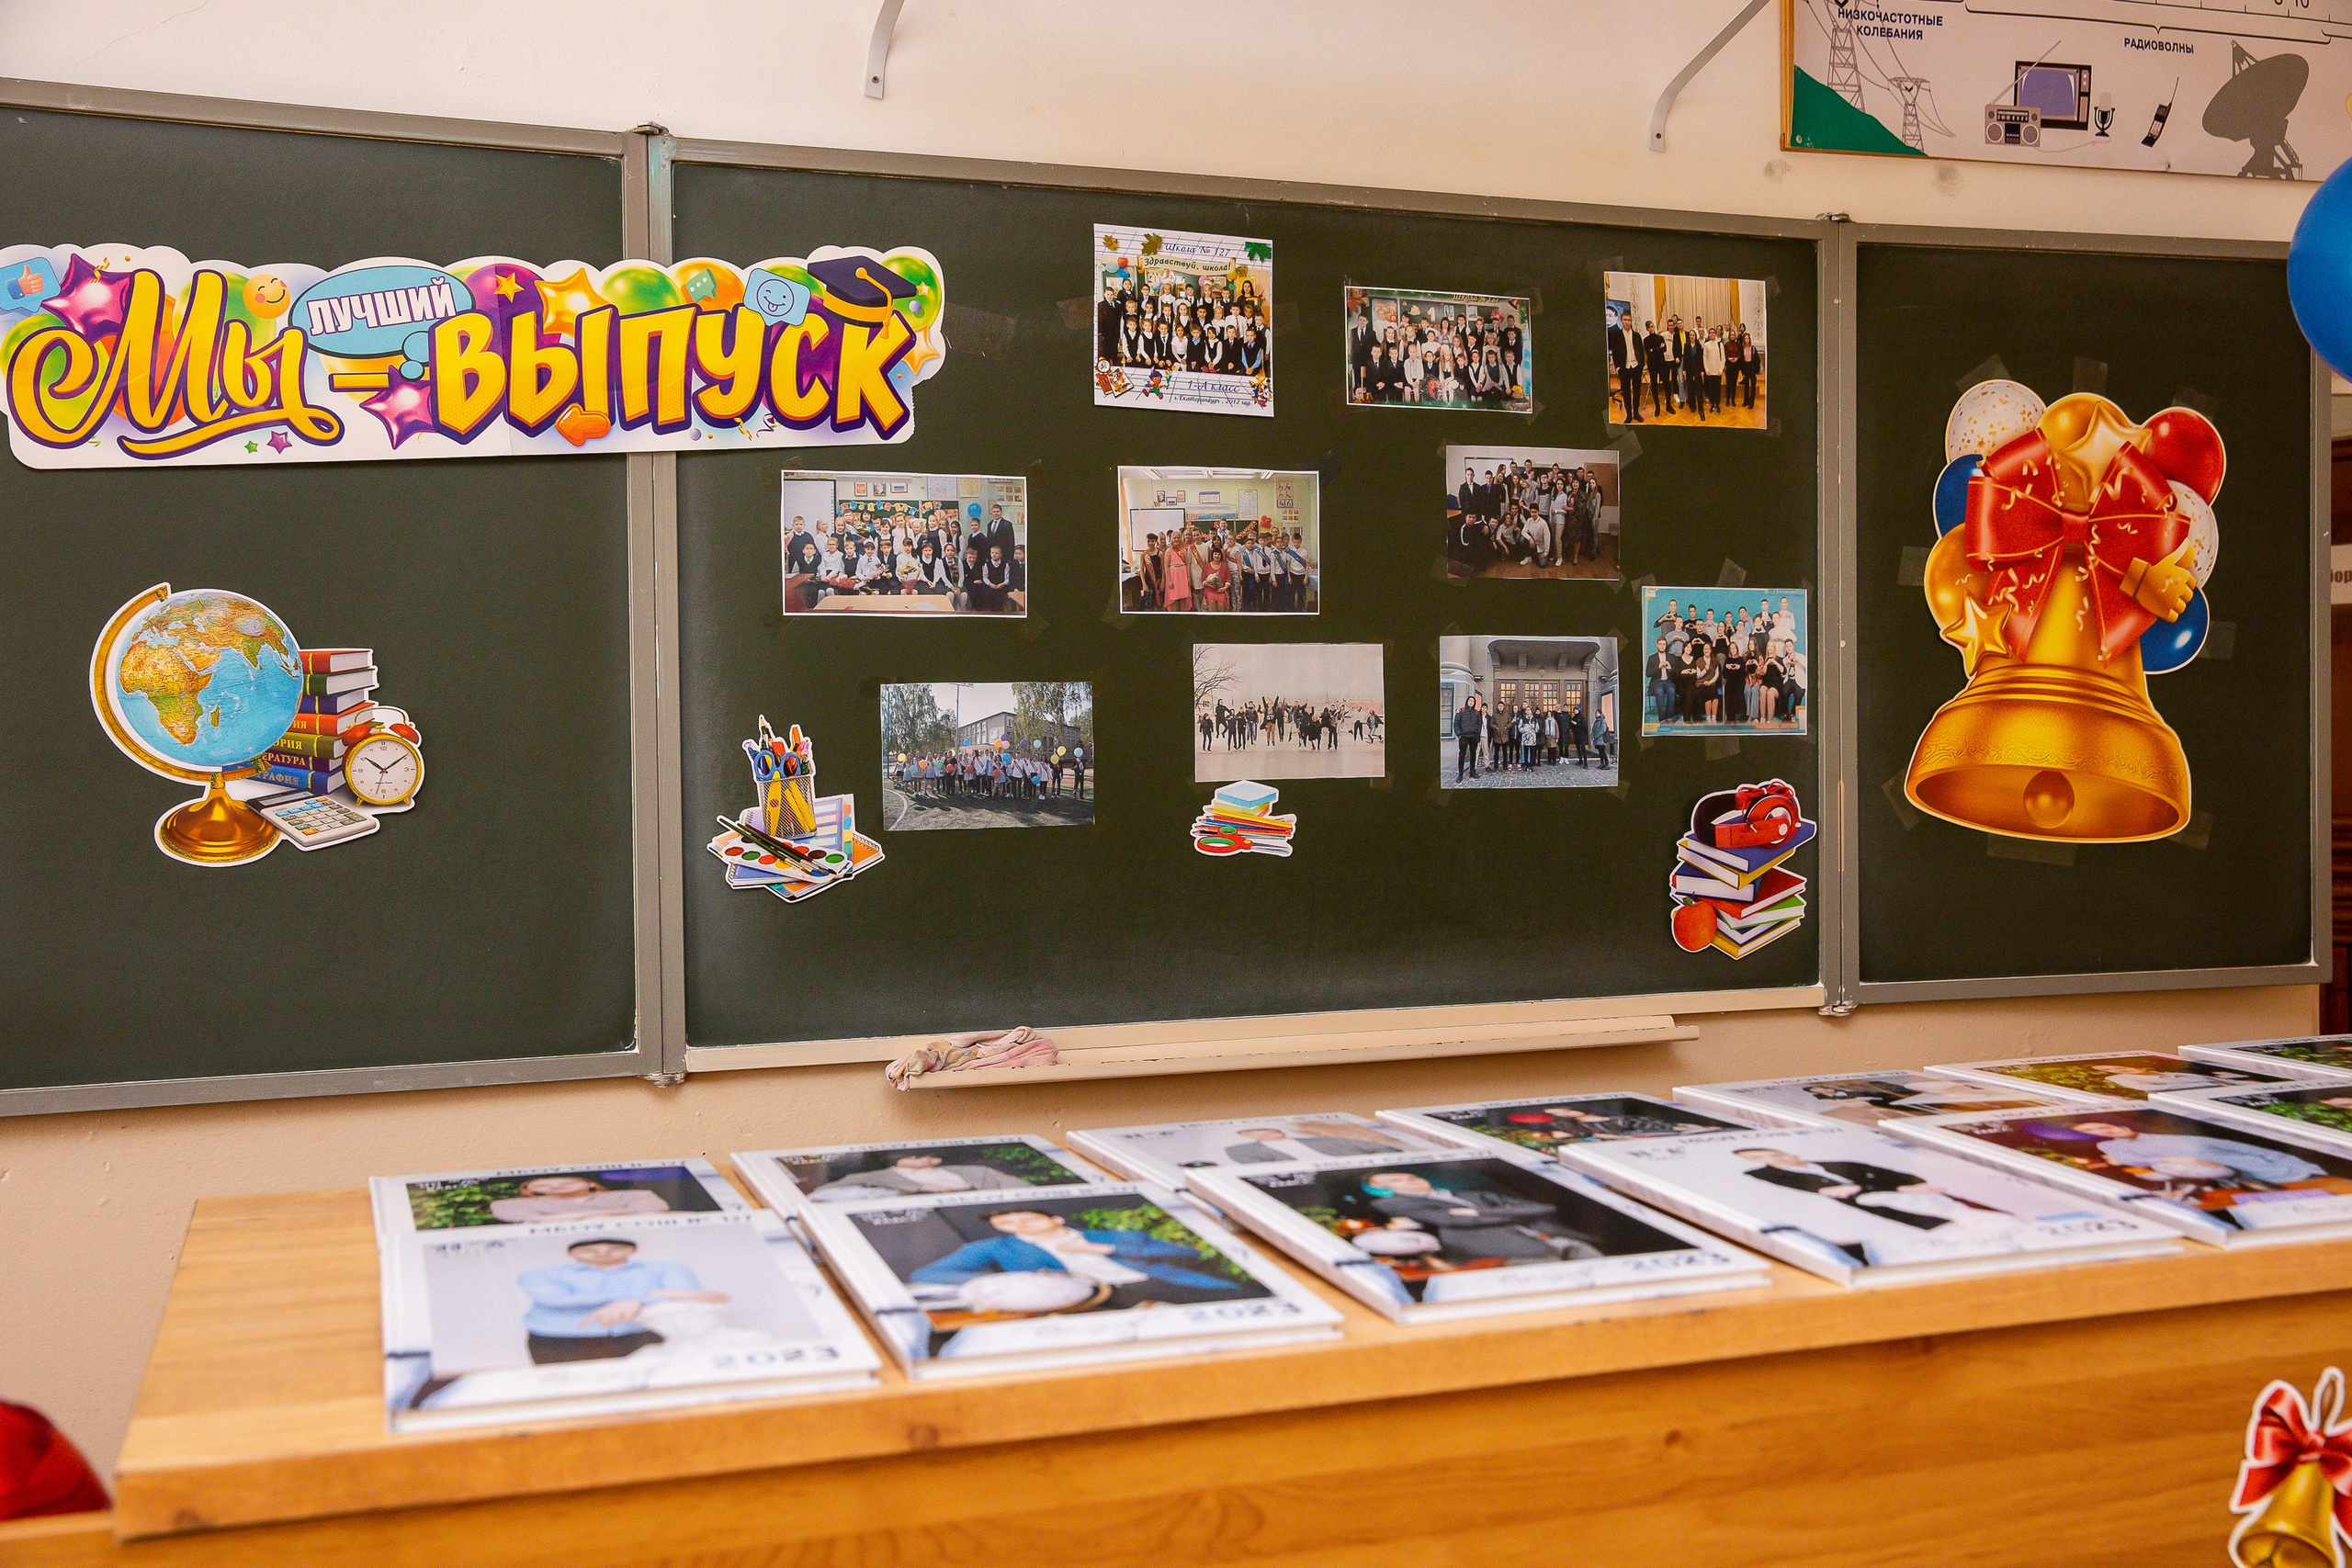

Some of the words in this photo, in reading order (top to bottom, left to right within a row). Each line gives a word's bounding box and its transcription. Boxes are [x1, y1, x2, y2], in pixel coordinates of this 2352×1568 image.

[1838, 8, 1943, 26] НИЗКОЧАСТОТНЫЕ
[1856, 25, 1923, 40] КОЛЕБАНИЯ
[2123, 38, 2194, 54] РАДИОВОЛНЫ
[1215, 247, 1231, 256] 127
[1202, 262, 1231, 271] школа!
[307, 276, 457, 335] ЛУЧШИЙ
[7, 268, 344, 459] Мы
[429, 304, 913, 442] ВЫПУСК
